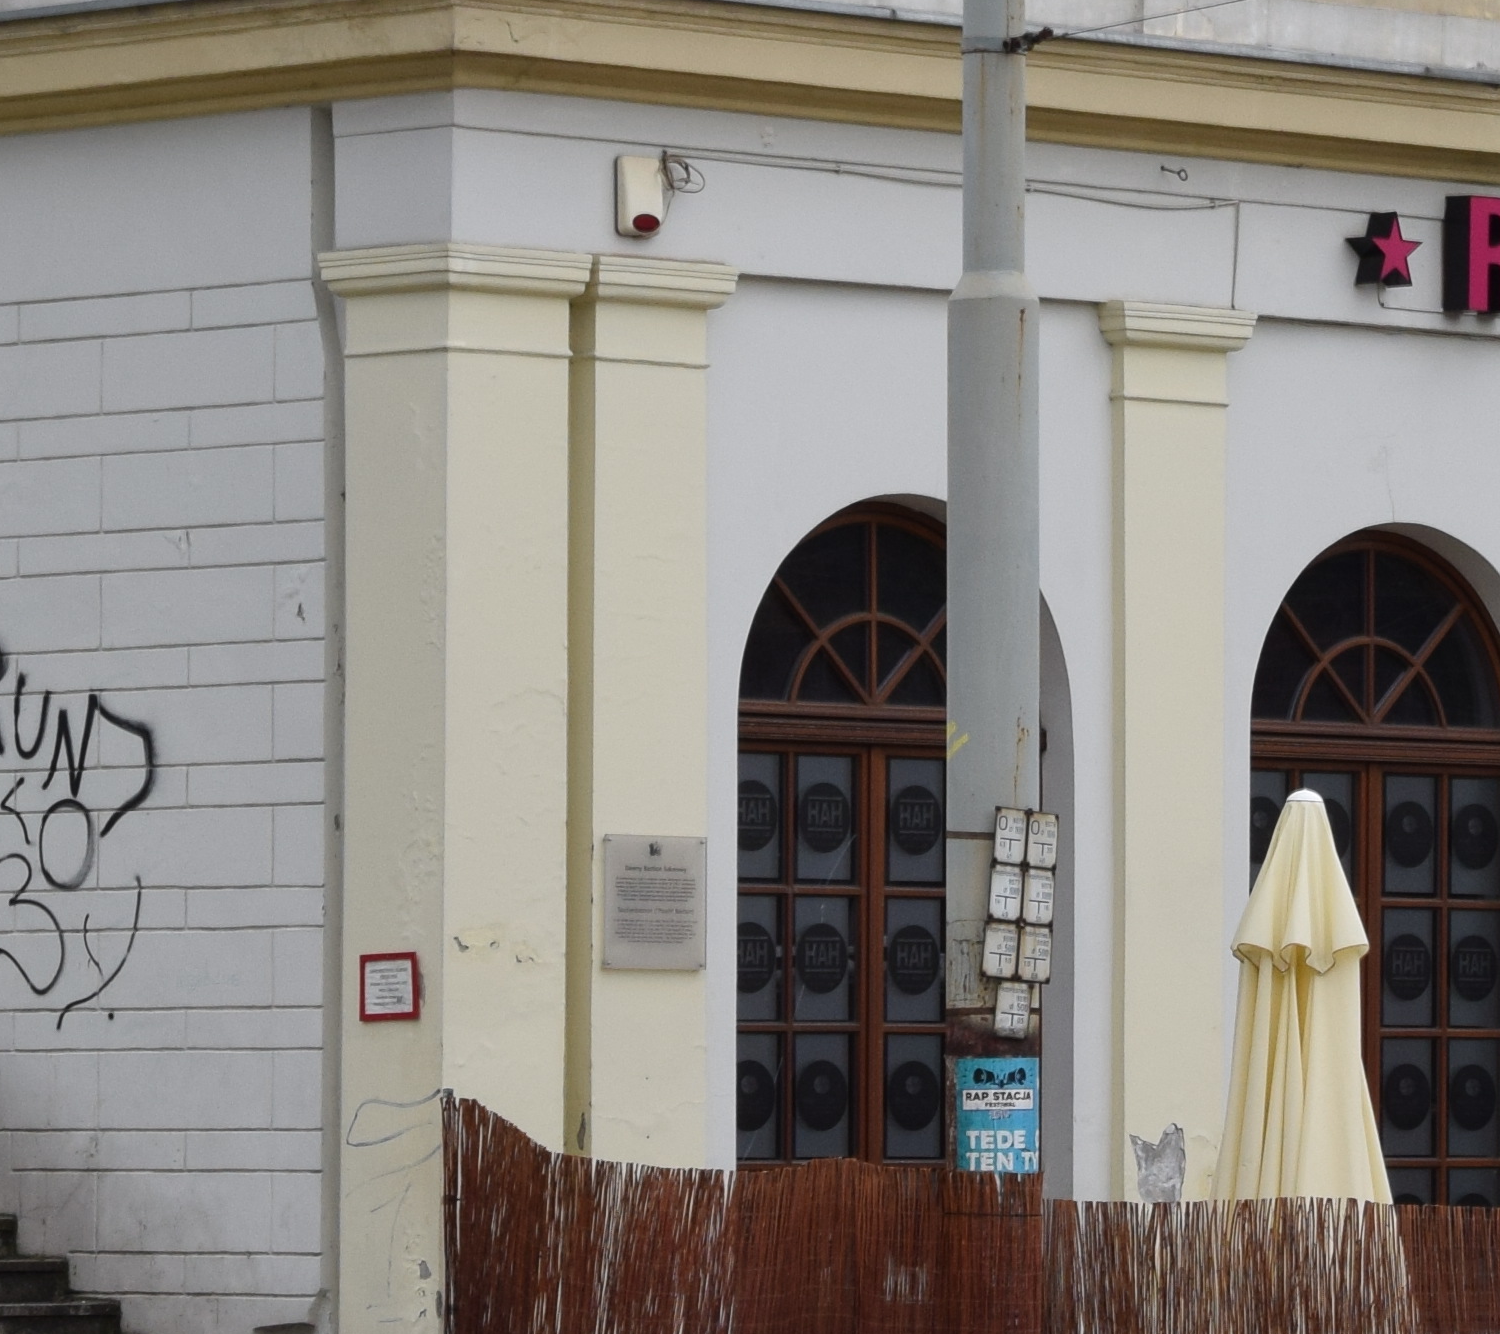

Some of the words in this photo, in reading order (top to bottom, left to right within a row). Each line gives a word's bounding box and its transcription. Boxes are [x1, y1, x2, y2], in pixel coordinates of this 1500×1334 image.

[965, 1091, 989, 1102] RAP
[993, 1091, 1031, 1101] STACJA
[965, 1130, 1027, 1149] TEDE
[965, 1152, 1014, 1171] TEN
